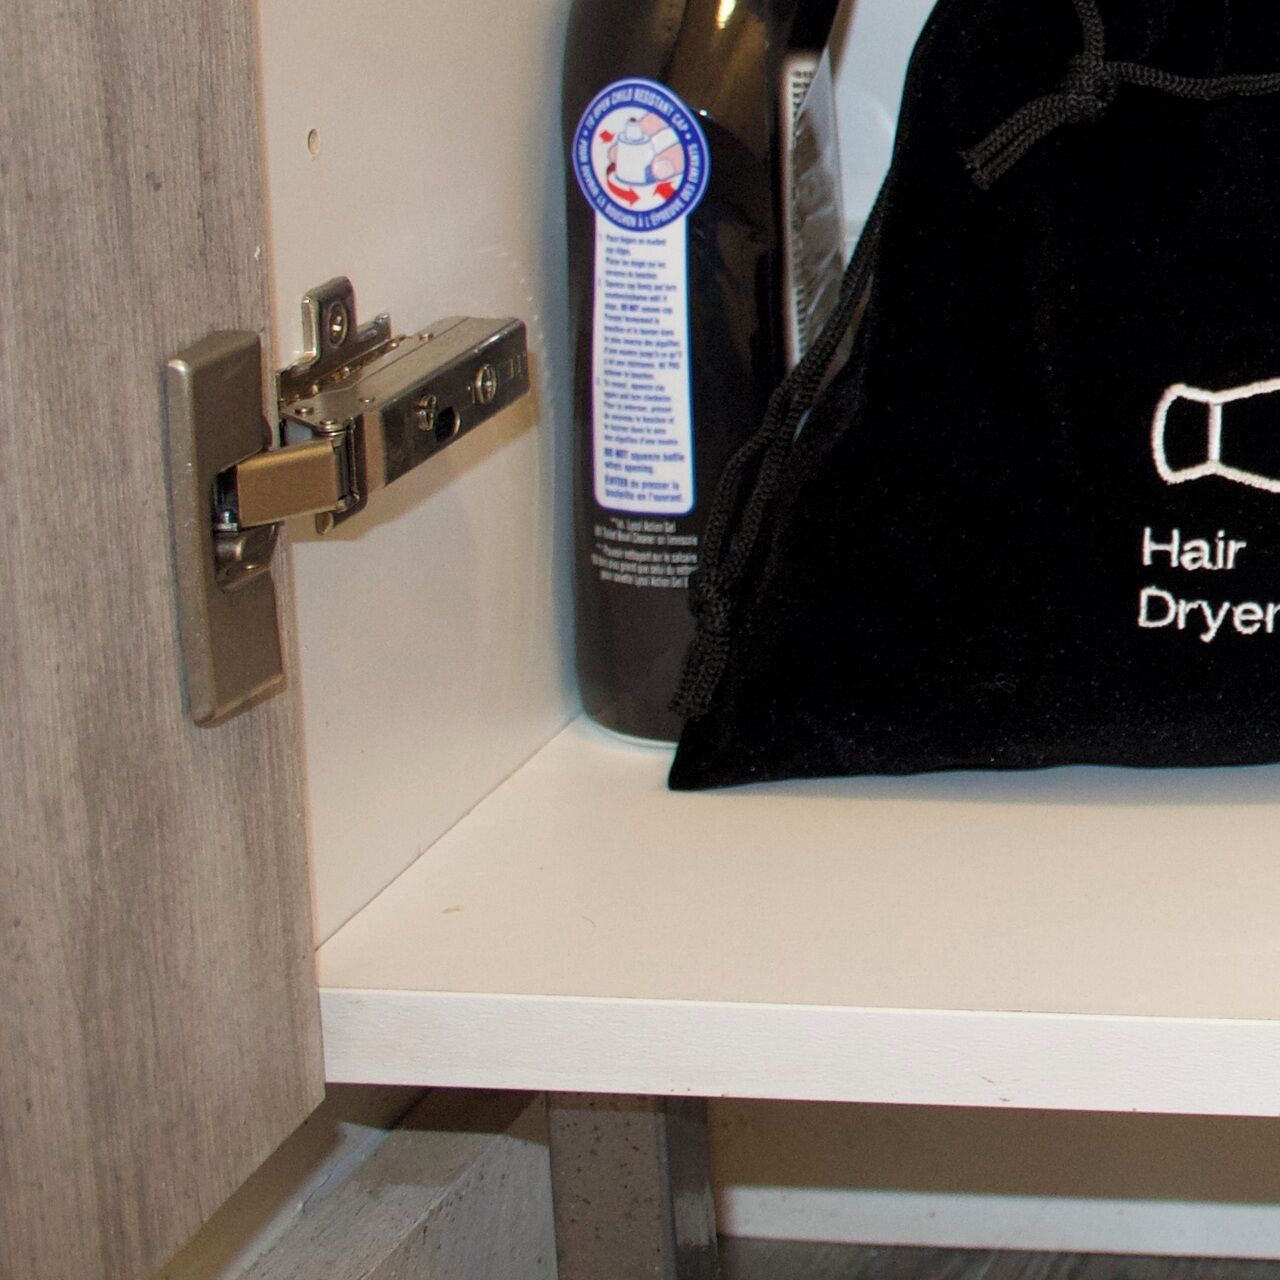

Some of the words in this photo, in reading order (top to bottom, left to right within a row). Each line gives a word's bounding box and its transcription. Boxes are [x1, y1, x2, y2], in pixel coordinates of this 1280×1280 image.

[611, 88, 634, 104] CHILD
[634, 88, 674, 116] RESISTANT
[671, 114, 690, 132] CAP
[1142, 526, 1247, 571] Hair
